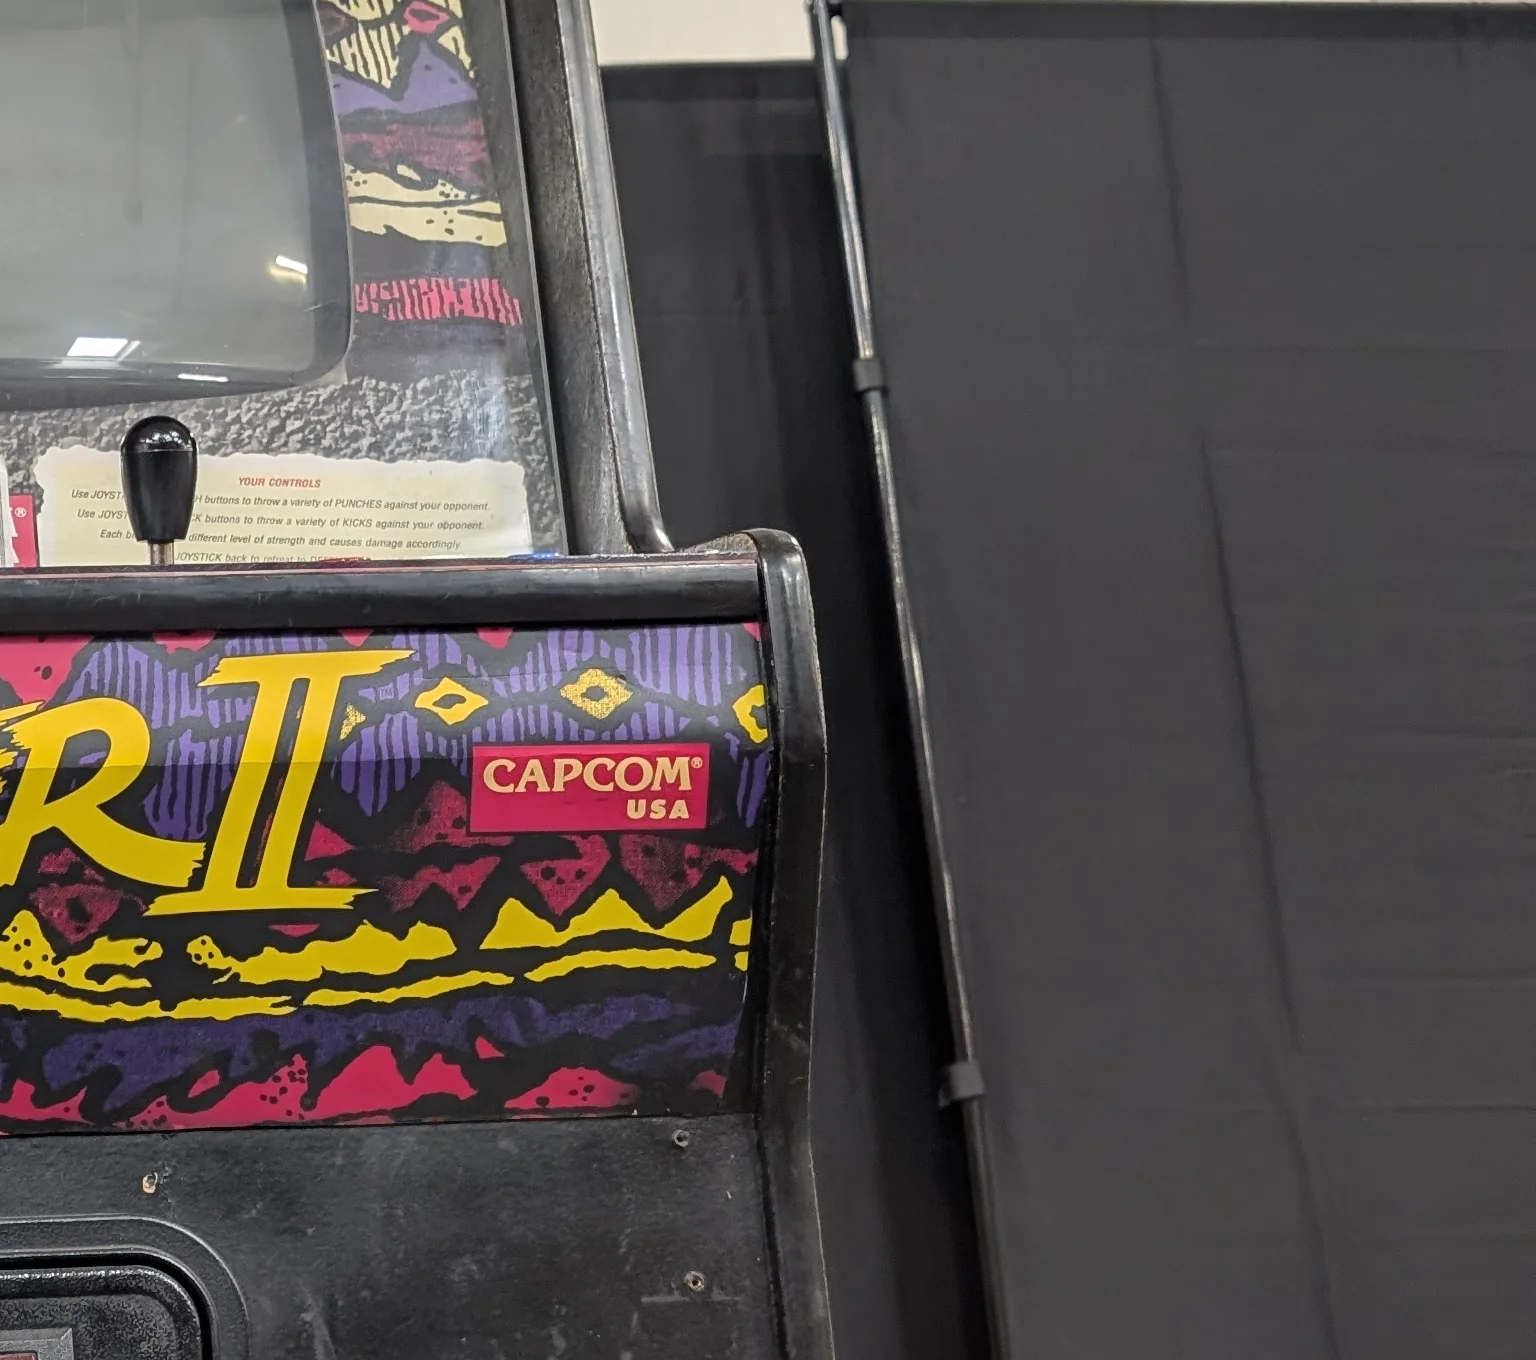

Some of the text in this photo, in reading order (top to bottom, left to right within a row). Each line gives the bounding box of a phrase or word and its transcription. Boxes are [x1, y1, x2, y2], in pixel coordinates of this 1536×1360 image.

[238, 477, 321, 488] YOUR CONTROLS
[71, 489, 89, 499] Use
[90, 490, 124, 500] JOYST
[204, 495, 240, 504] buttons
[242, 496, 251, 505] to
[253, 496, 280, 506] throw
[282, 499, 288, 507] a
[290, 498, 320, 508] variety
[323, 498, 333, 508] of
[334, 498, 382, 509] PUNCHES
[384, 500, 418, 511] against
[420, 502, 441, 512] your
[77, 508, 95, 518] Use
[97, 509, 128, 519] JOYST
[205, 514, 240, 524] buttons
[244, 516, 253, 525] to
[257, 516, 283, 525] throw
[286, 518, 292, 526] a
[295, 517, 326, 527] variety
[329, 518, 340, 527] of
[342, 517, 372, 528] KICKS
[375, 519, 410, 530] against
[412, 521, 433, 531] your
[100, 529, 123, 539] Each
[188, 533, 227, 543] different
[229, 534, 251, 544] level
[254, 534, 264, 544] of
[267, 535, 306, 546] strength
[308, 536, 326, 546] and
[329, 538, 362, 547] causes
[365, 538, 403, 550] damage
[175, 551, 223, 562] JOYSTICK
[225, 553, 247, 562] back
[250, 554, 260, 562] to
[144, 648, 415, 917] II
[626, 799, 690, 820] USA
